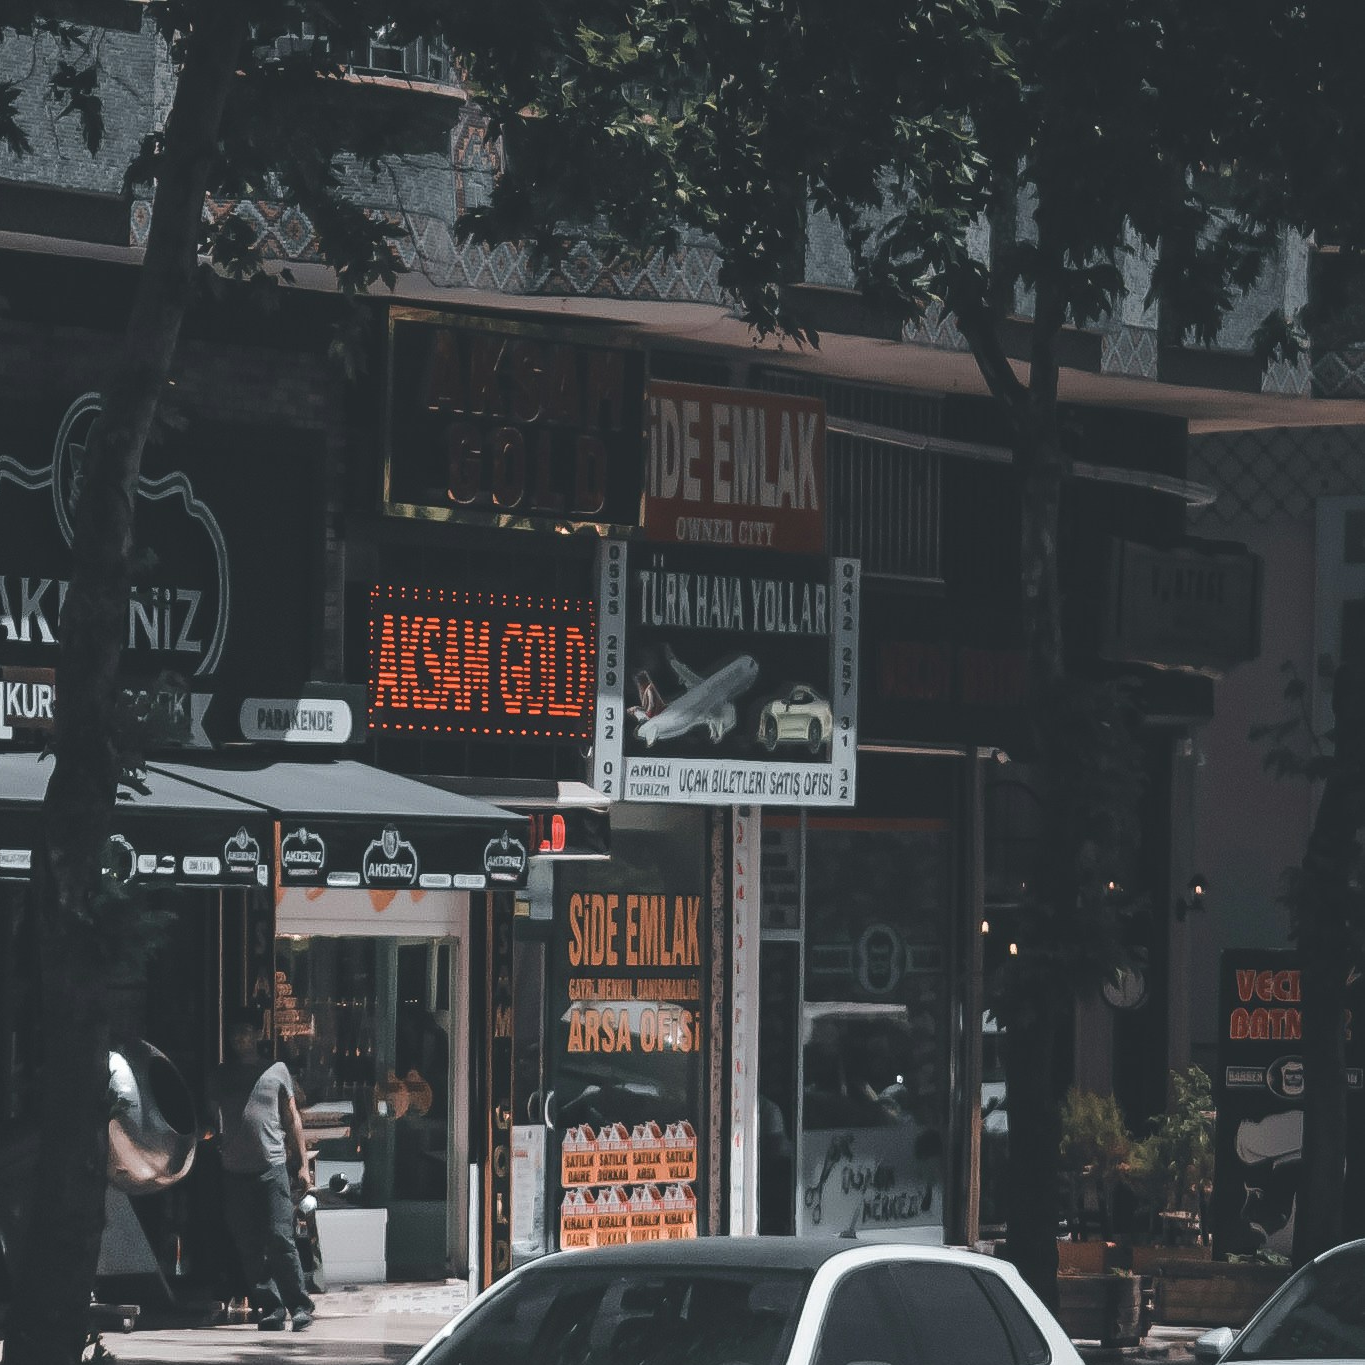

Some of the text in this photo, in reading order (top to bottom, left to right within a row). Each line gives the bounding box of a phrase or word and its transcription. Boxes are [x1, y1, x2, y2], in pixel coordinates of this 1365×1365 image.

[444, 422, 608, 514] GOLD
[649, 396, 819, 510] İDE EMLAK
[675, 516, 775, 546] OWNER CITY
[638, 553, 692, 627] TÜRK
[696, 574, 745, 631] HAVA
[499, 622, 587, 717] GOLD
[257, 707, 333, 731] PARAKENDE
[604, 707, 615, 740] 32
[602, 761, 614, 793] 02
[625, 893, 701, 967] EMLAK
[567, 1008, 633, 1053] ARSA
